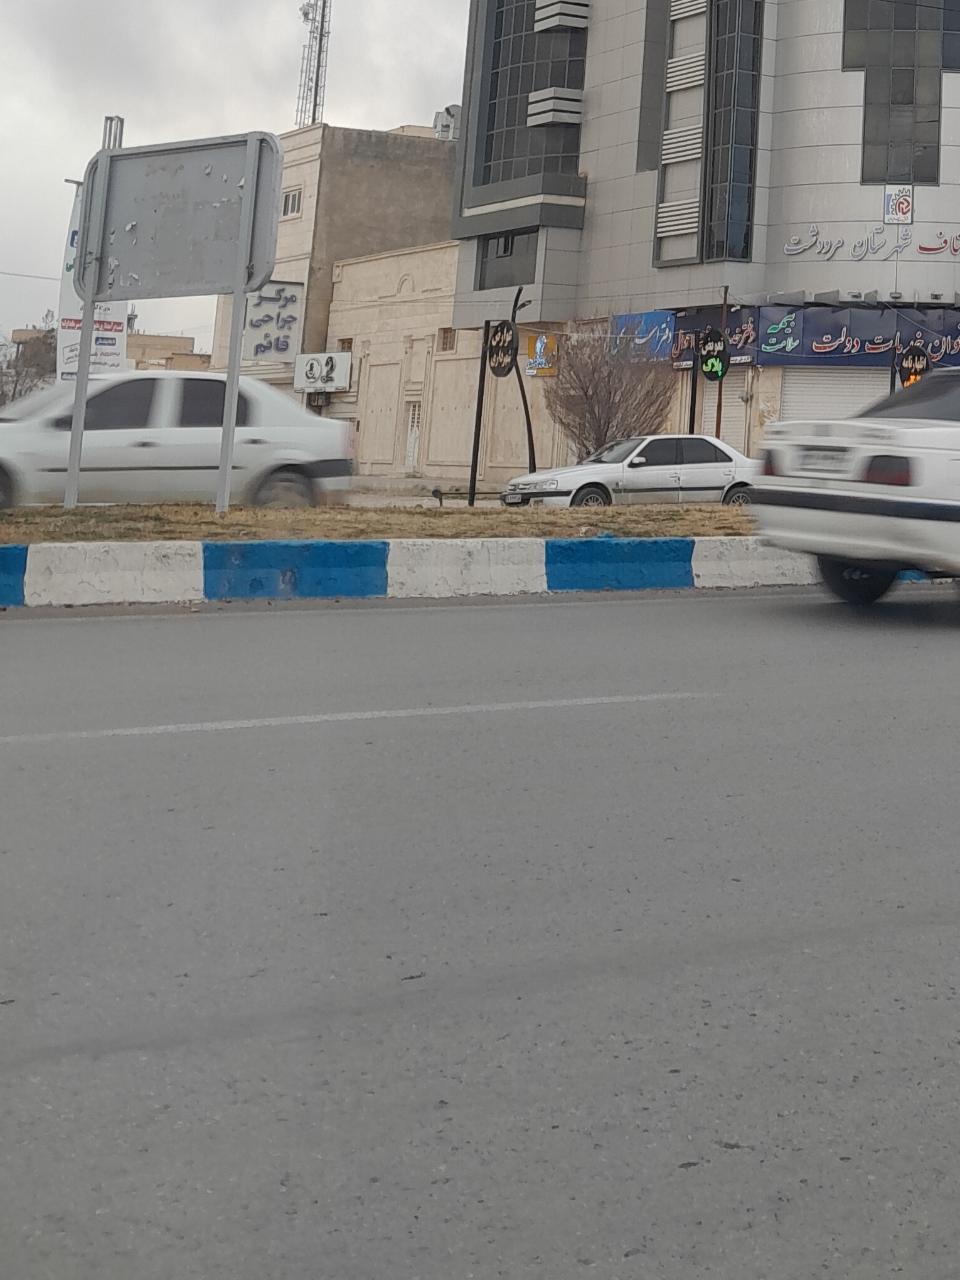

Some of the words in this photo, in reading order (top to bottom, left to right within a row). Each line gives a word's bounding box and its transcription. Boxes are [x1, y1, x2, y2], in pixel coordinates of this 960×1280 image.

[783, 223, 844, 261] مرودشت
[850, 225, 913, 261] شهرستان
[253, 287, 297, 308] مرکز
[250, 311, 298, 330] جراحی
[766, 312, 796, 334] بیمه
[254, 333, 289, 356] قائم
[761, 336, 799, 352] سلامت
[812, 326, 860, 353] دولت
